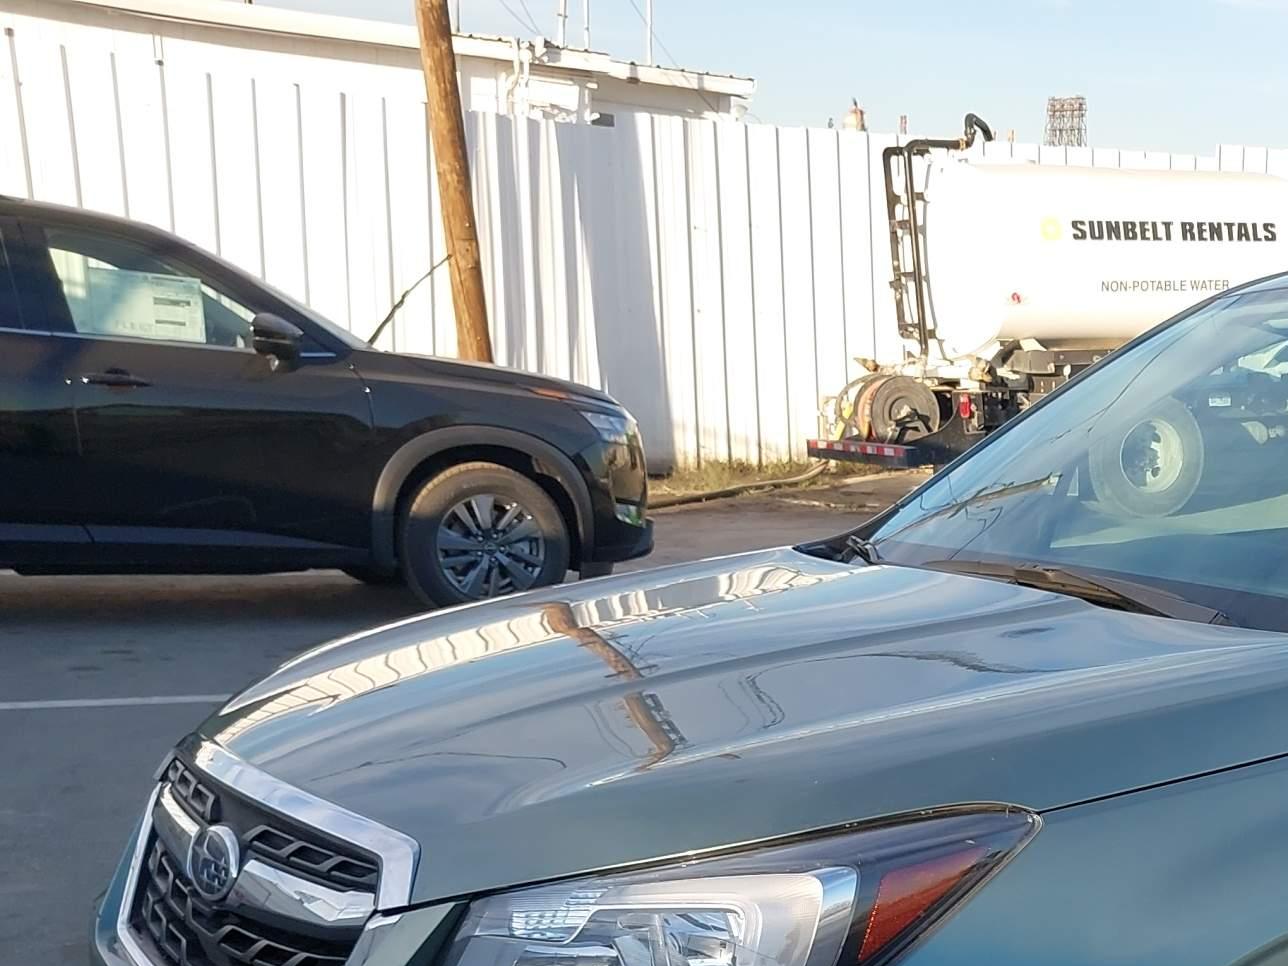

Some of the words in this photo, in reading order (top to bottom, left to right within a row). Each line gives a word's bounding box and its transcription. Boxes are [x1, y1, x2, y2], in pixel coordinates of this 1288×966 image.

[1071, 220, 1174, 241] SUNBELT
[1181, 221, 1277, 242] RENTALS
[1101, 280, 1187, 292] NON-POTABLE
[1190, 279, 1230, 291] WATER
